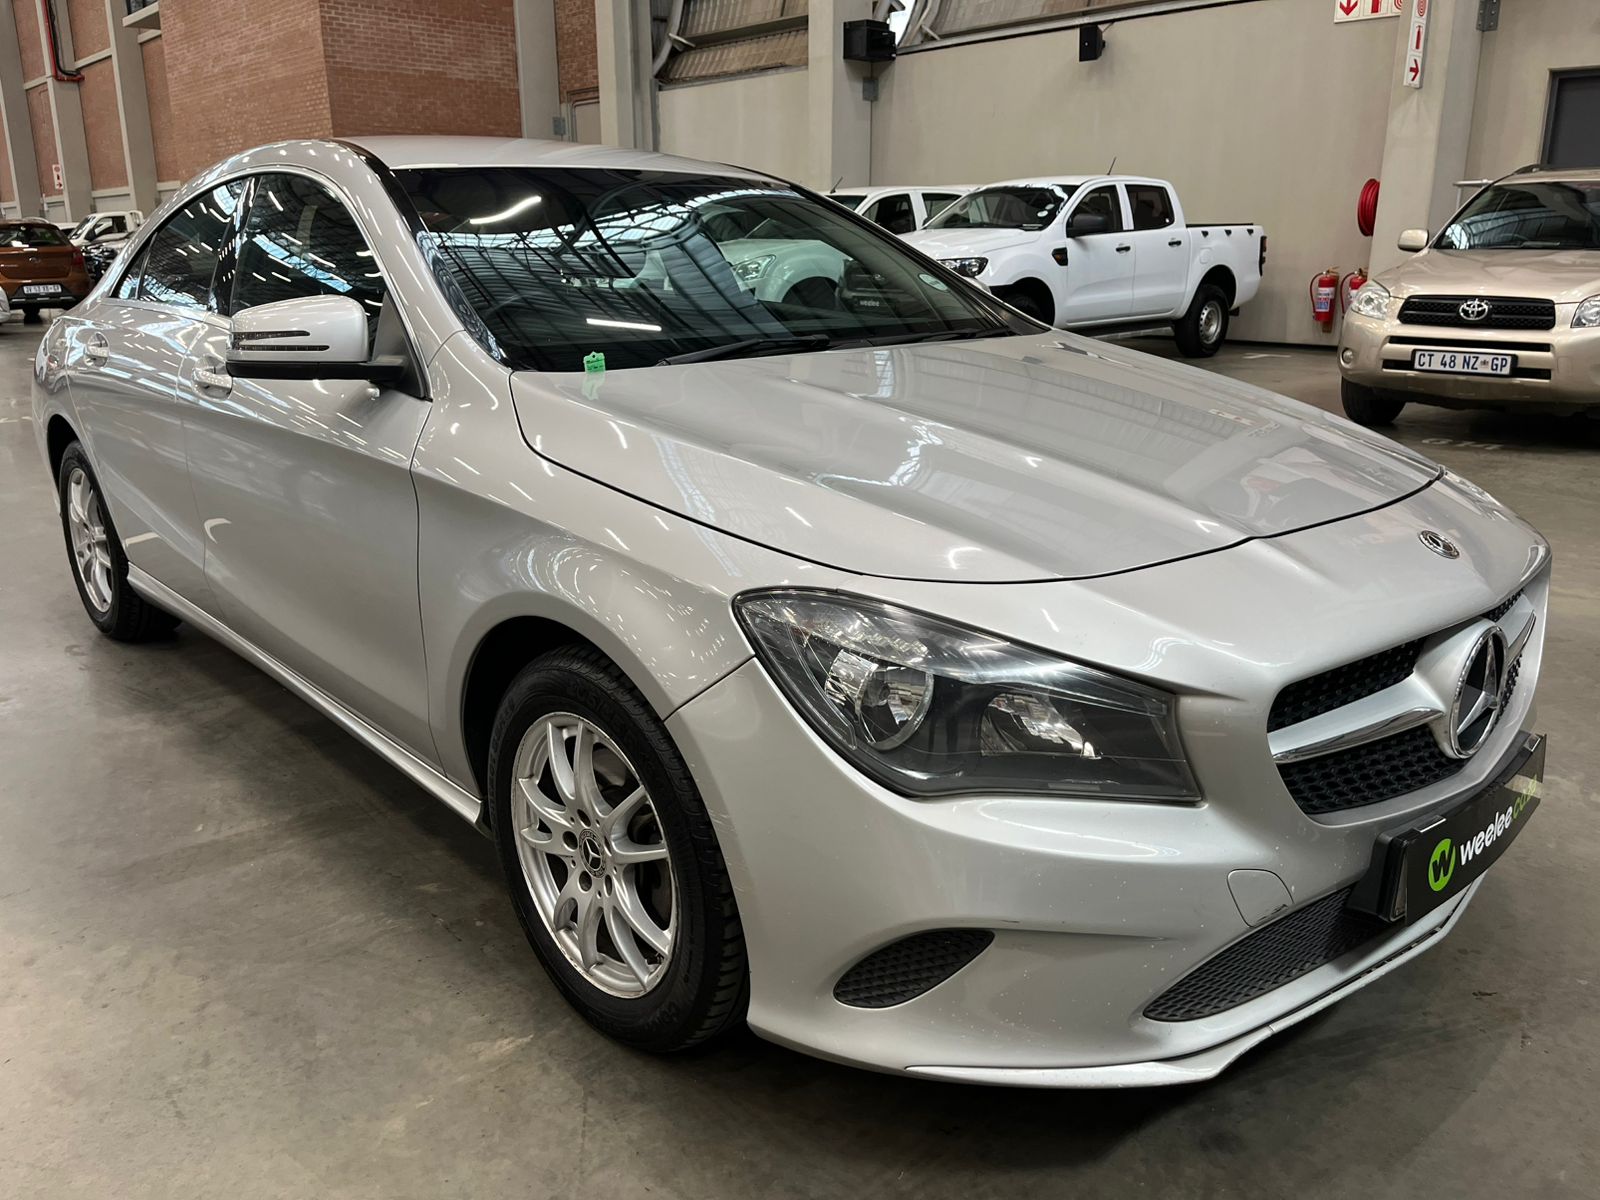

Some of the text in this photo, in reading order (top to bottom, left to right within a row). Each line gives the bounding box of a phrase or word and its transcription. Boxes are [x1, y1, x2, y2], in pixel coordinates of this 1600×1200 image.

[1418, 353, 1508, 372] CT 48 NZ GP
